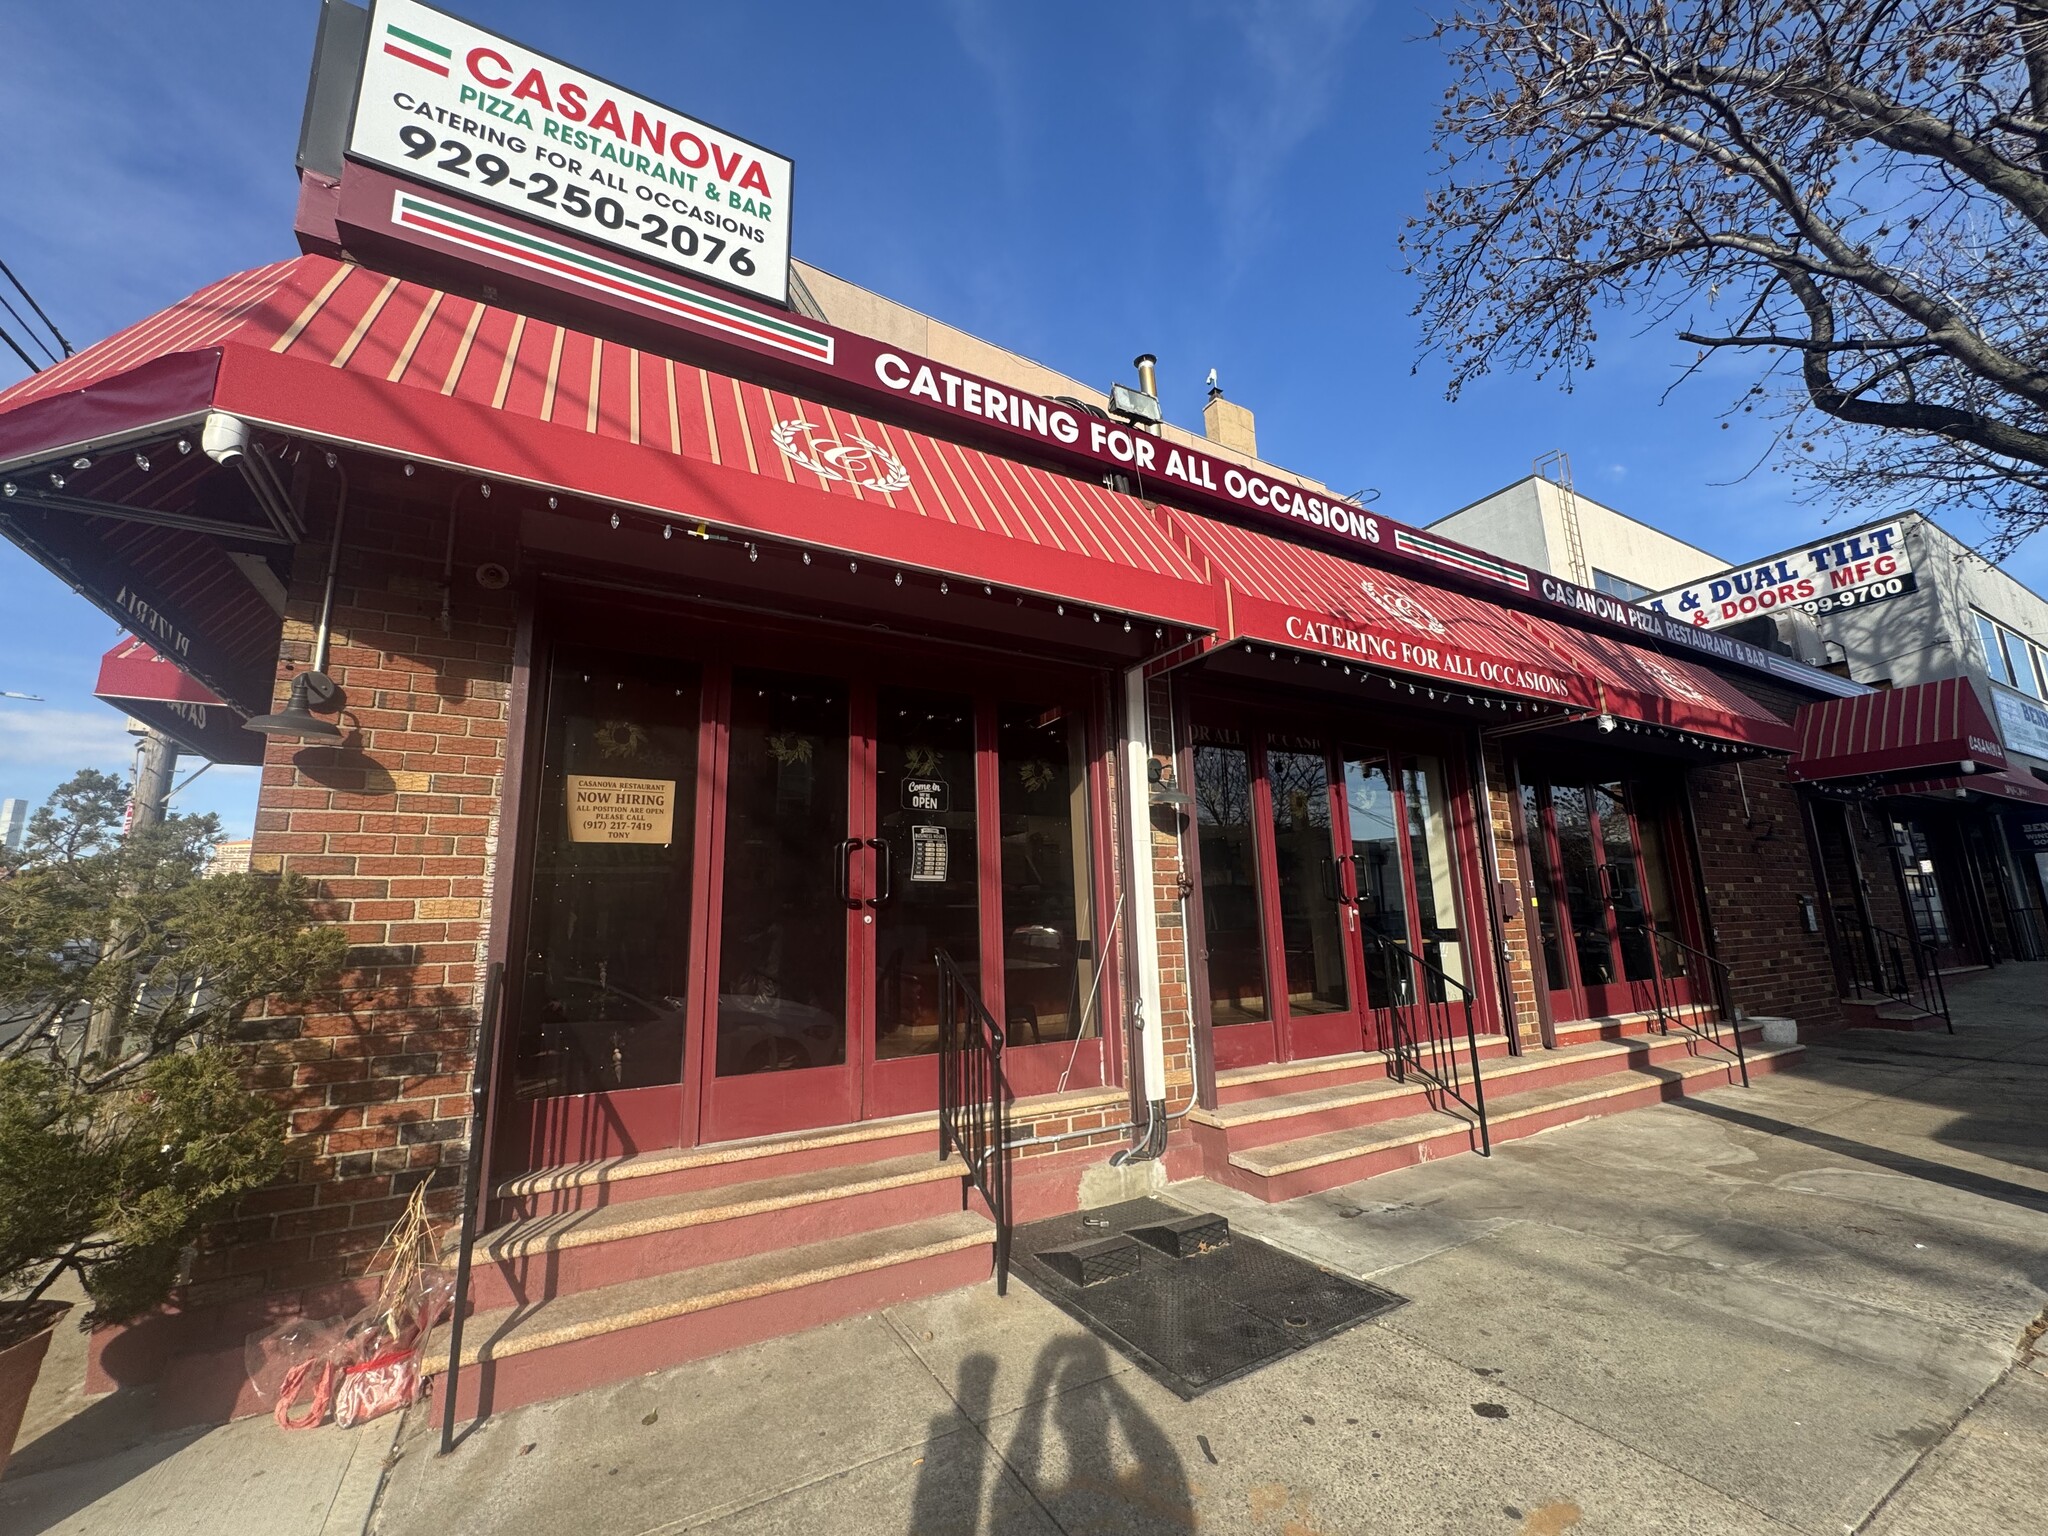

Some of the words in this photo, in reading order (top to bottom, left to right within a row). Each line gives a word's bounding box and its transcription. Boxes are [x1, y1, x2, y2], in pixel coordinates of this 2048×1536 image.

[459, 85, 533, 131] PIZZA
[543, 121, 699, 193] RESTAURANT
[705, 183, 721, 201] &
[728, 190, 772, 222] BAR
[466, 47, 772, 199] CASANOVA
[393, 92, 527, 154] CATERING
[535, 146, 583, 178] FOR
[589, 163, 628, 194] ALL
[636, 185, 765, 244] OCCASIONS
[399, 125, 757, 278] 929-250-2076
[874, 353, 1079, 444] CATERING
[1091, 422, 1156, 473] FOR
[1164, 451, 1217, 492] ALL
[1223, 470, 1380, 544] OCCASIONS
[1678, 590, 1701, 612] &
[1708, 560, 1799, 603] DUAL
[1808, 527, 1895, 573] TILT
[1693, 610, 1710, 627] &
[1721, 579, 1815, 619] DOORS
[1829, 555, 1897, 589] MFG
[1795, 578, 1903, 616] 99-9700
[1285, 616, 1397, 660] CATERING
[1401, 642, 1440, 670] FOR
[1444, 655, 1478, 679] ALL
[1480, 661, 1569, 697] OCCASIONS
[1542, 578, 1627, 626] CASANOVA
[1629, 608, 1664, 637] PIZZA
[1665, 620, 1734, 658] RESTAURANT
[1736, 644, 1744, 661] &
[1747, 648, 1767, 668] BAR
[577, 792, 611, 803] NOW
[616, 794, 665, 806] HIRING
[578, 780, 617, 788] CASANOVA
[619, 783, 665, 791] RESTAURANT
[908, 781, 931, 793] Come
[912, 796, 937, 809] OPEN
[583, 820, 607, 830] (917)
[610, 821, 652, 831] 217-7419
[608, 831, 630, 839] TONY
